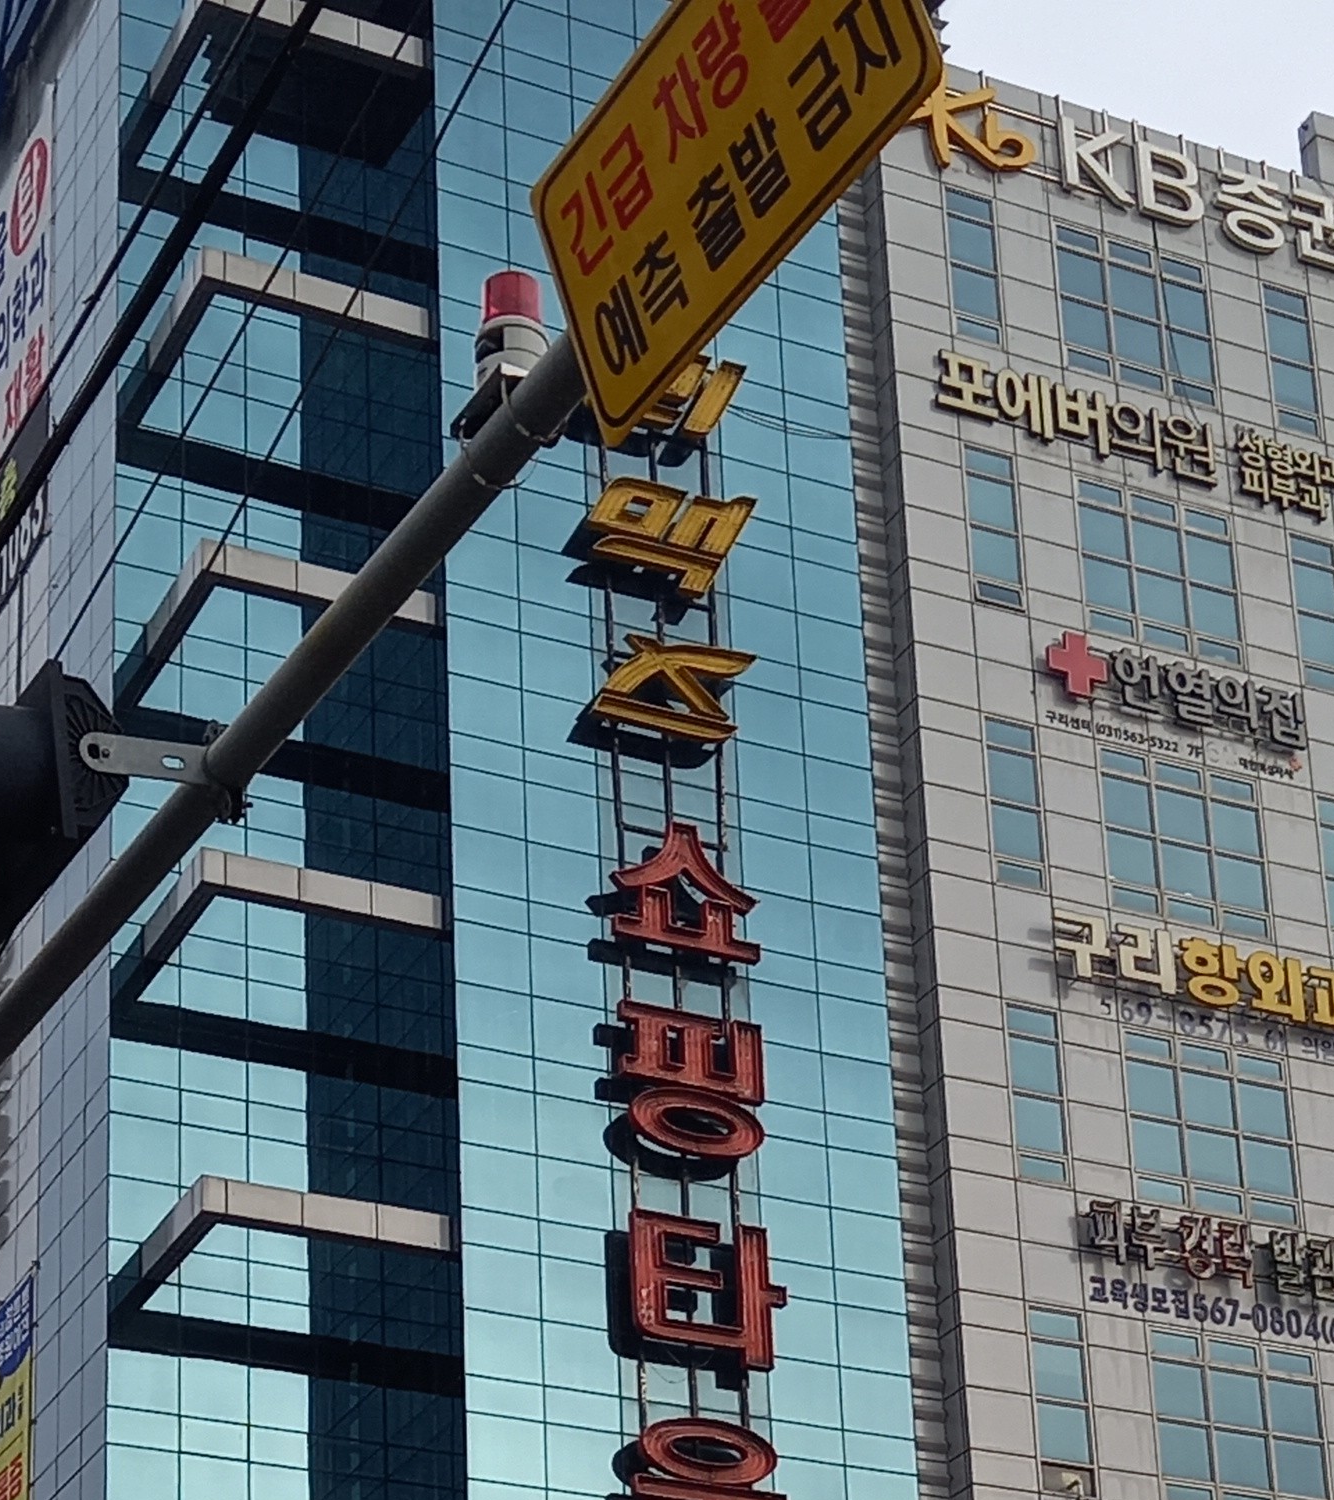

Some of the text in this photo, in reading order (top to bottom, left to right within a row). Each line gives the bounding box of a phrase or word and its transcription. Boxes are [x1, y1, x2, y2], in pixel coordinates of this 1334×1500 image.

[560, 0, 749, 277] 긴급 차량
[594, 230, 690, 376] 예측
[686, 107, 791, 273] 출발
[787, 0, 902, 152] 금지
[935, 350, 1218, 489] 포에버의원
[1241, 467, 1329, 521] 피부과
